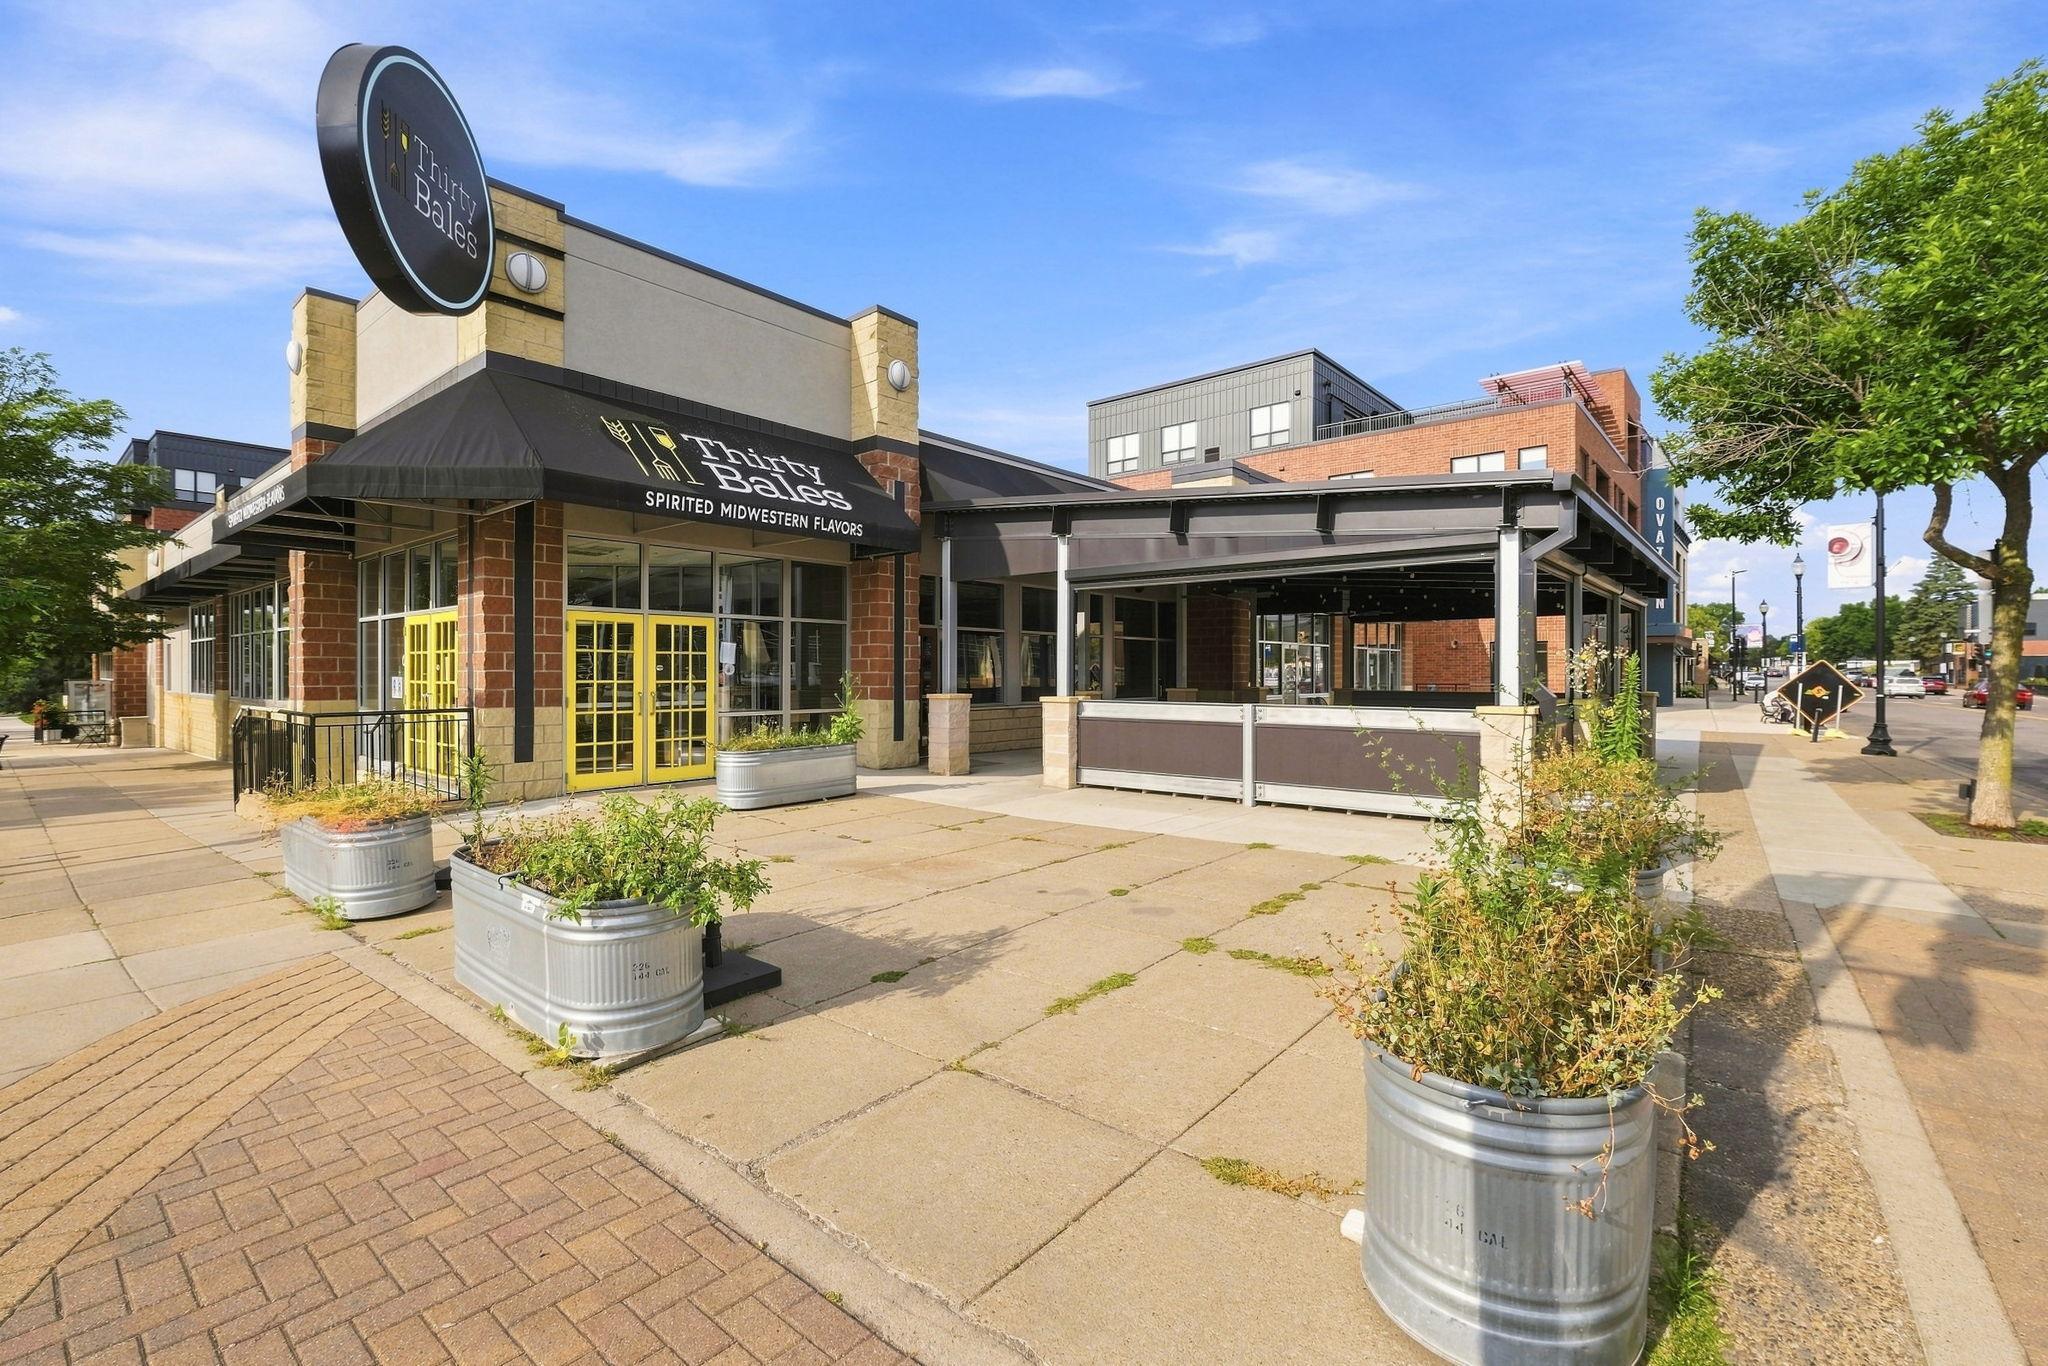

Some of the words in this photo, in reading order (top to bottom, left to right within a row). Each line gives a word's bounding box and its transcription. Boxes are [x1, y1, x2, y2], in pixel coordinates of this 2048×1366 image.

[414, 135, 477, 225] Thirty
[414, 172, 477, 260] Bales
[681, 433, 825, 486] Thirty
[701, 460, 853, 511] Bales
[645, 491, 714, 515] SPIRITED
[720, 502, 809, 529] MIDWESTERN
[813, 516, 863, 537] FLAVORS
[1655, 497, 1665, 609] OVATN
